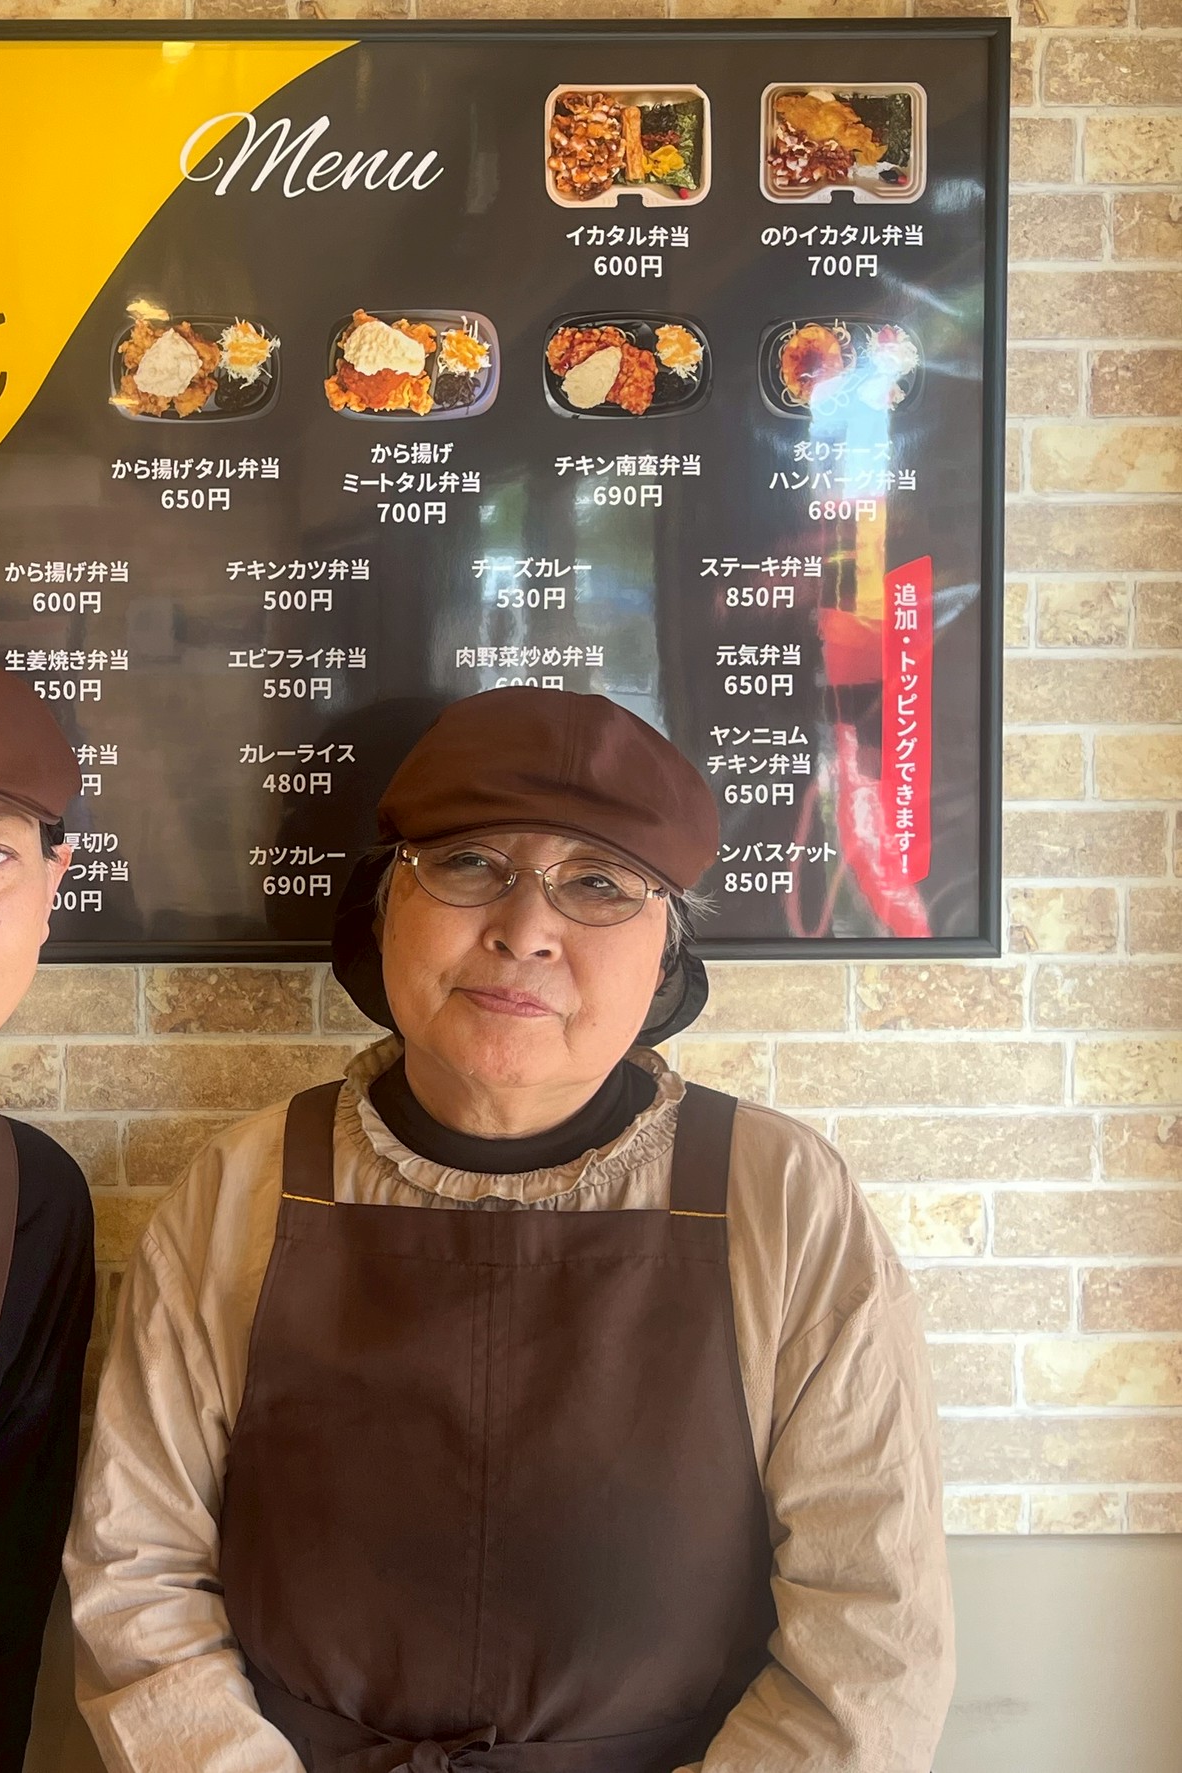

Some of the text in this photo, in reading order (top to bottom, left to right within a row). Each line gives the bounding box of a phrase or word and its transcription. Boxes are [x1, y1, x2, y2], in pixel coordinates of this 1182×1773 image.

[179, 112, 444, 198] Menu
[566, 226, 688, 247] イカタル弁当
[761, 225, 922, 246] のりイカタル弁当
[595, 256, 662, 277] 600円
[809, 255, 877, 277] 700円
[371, 443, 453, 464] から揚げ
[793, 441, 894, 462] 炙りチーズ
[112, 457, 279, 479] から揚げタル弁当
[554, 455, 701, 477] チキン南蛮弁当
[343, 471, 480, 493] ミートタル弁当
[769, 469, 917, 491] ハンバーグ弁当
[162, 489, 229, 510] 650円
[593, 485, 663, 507] 690円
[377, 502, 445, 524] 700円
[808, 500, 877, 522] 680円
[5, 561, 128, 582] から揚げ弁当
[226, 559, 369, 580] チキンカツ弁当
[471, 558, 591, 579] チーズカレー
[701, 556, 822, 577] ステーキ弁当
[33, 592, 100, 613] 600円
[264, 590, 332, 611] 500円
[496, 587, 566, 610] 530円
[726, 587, 794, 608] 850円
[5, 649, 128, 671] 生姜焼き弁当
[228, 647, 366, 668] エビフライ弁当
[456, 646, 604, 668] 肉野菜炒め弁当
[717, 644, 800, 665] 元気弁当
[35, 680, 101, 701] 550円
[264, 678, 331, 699] 550円
[725, 675, 792, 696] 650円
[710, 726, 808, 745] ヤンニョム
[72, 744, 118, 765] 弁当
[240, 744, 355, 763] カレーライス
[707, 753, 810, 774] チキン弁当
[263, 773, 331, 794] 480円
[725, 784, 793, 805] 650円
[249, 846, 345, 865] カツカレー
[717, 842, 837, 862] ンバスケット
[263, 875, 330, 896] 690円
[725, 872, 793, 893] 850円
